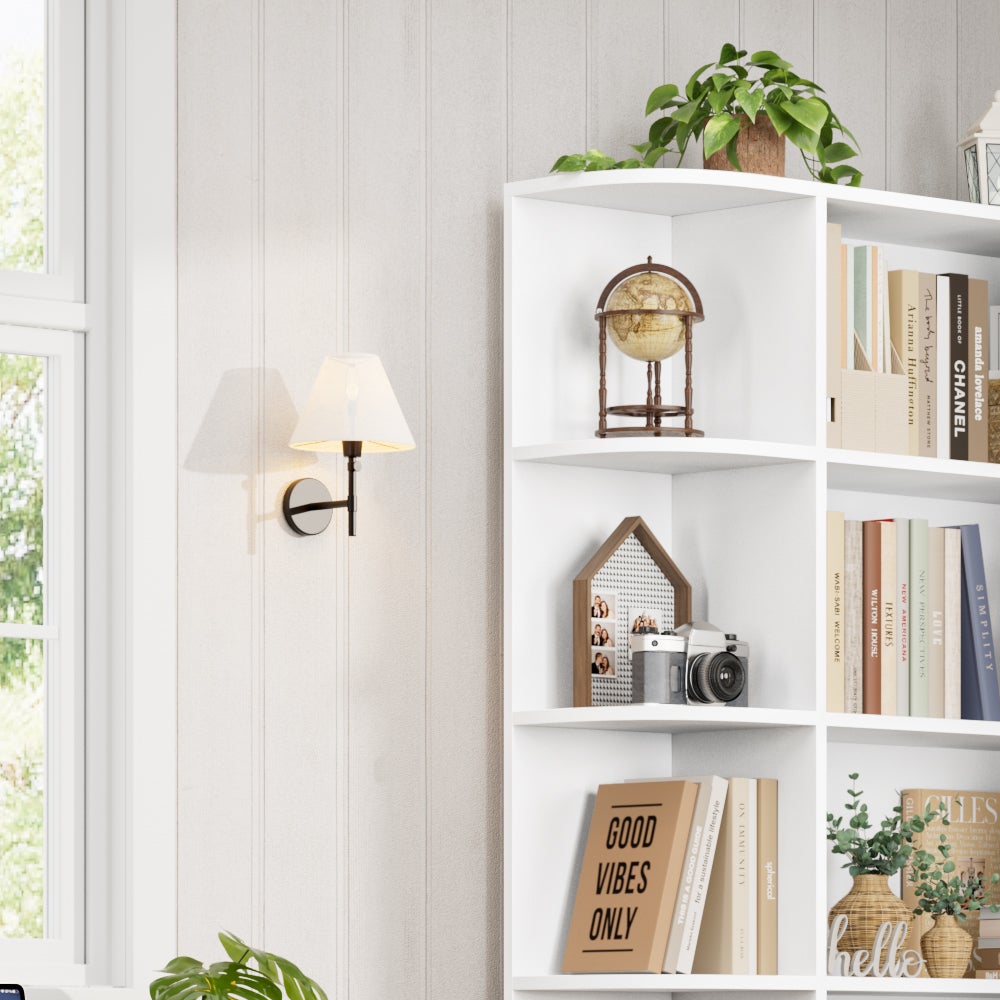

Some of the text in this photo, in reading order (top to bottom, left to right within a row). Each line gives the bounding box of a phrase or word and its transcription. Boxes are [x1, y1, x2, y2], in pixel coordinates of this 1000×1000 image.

[924, 288, 933, 311] The
[923, 316, 935, 340] body
[957, 335, 962, 344] OF
[907, 304, 917, 425] Arianna Huffington
[974, 326, 984, 421] amanda lovelace
[954, 359, 966, 437] CHANEL
[885, 602, 893, 648] TEXTURES
[975, 584, 994, 671] SIMPLITY
[605, 815, 657, 849] GOOD
[700, 834, 714, 882] sustainable
[710, 800, 721, 833] lifestyle
[595, 861, 651, 895] VIBES
[765, 861, 776, 900] spherical
[588, 907, 638, 941] ONLY
[827, 914, 927, 977] hello
